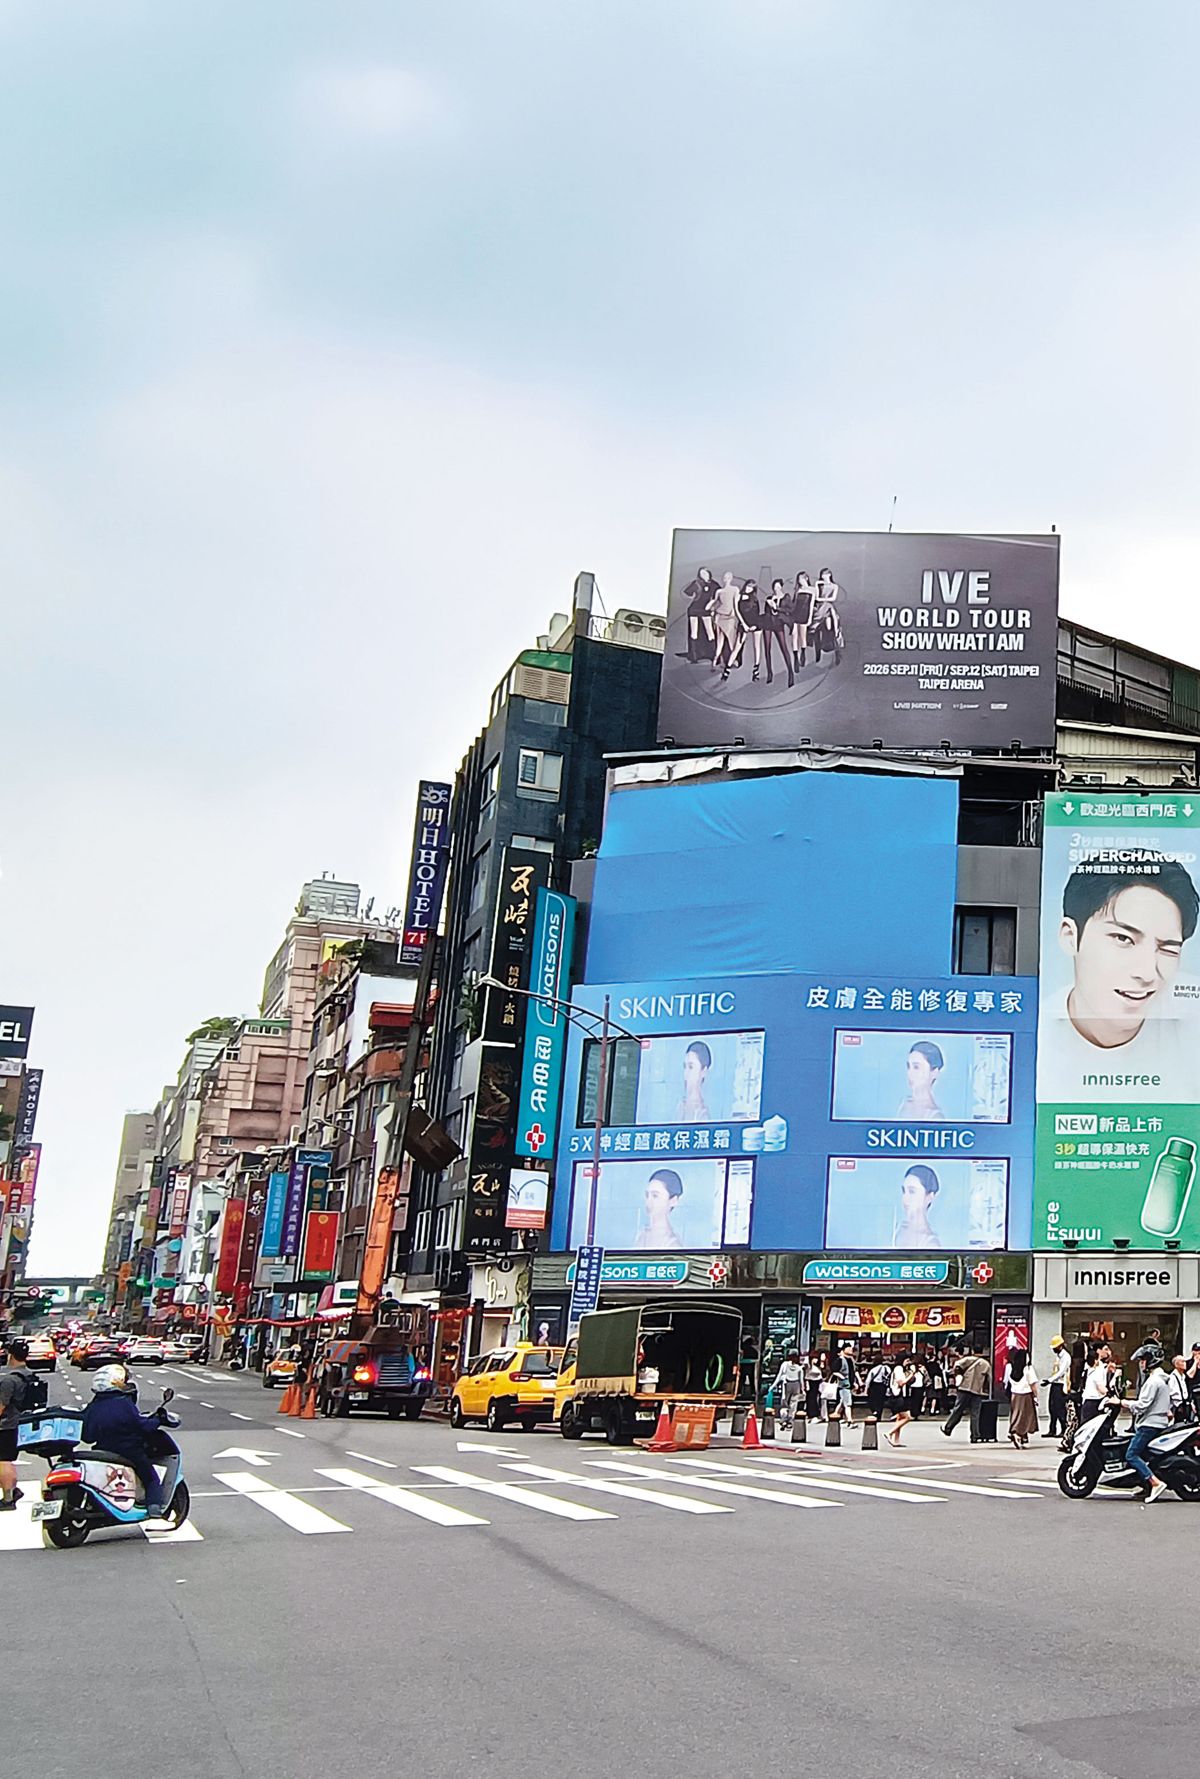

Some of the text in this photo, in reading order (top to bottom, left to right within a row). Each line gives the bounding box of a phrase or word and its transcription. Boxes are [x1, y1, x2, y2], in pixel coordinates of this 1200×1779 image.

[922, 570, 990, 605] IVE
[877, 608, 1031, 629] WORLD TOUR
[882, 632, 1025, 652] SHOW WHAT I AM
[863, 664, 889, 676] 2026
[1009, 666, 1040, 677] TAIPEI
[918, 678, 985, 691] TAIPEI ARENA
[1068, 849, 1196, 863] SUPERCHARGED
[413, 807, 443, 929] 明日 HOTEL
[542, 913, 560, 1006] watsons
[619, 991, 735, 1019] SKINTIFIC
[806, 985, 1022, 1014] 皮膚全能修復專家
[1058, 1116, 1163, 1132] NEW 新品上市
[867, 1129, 975, 1148] SKINTIFIC
[646, 1265, 677, 1278] 屈臣氏
[815, 1265, 937, 1278] watsons 屈臣氏
